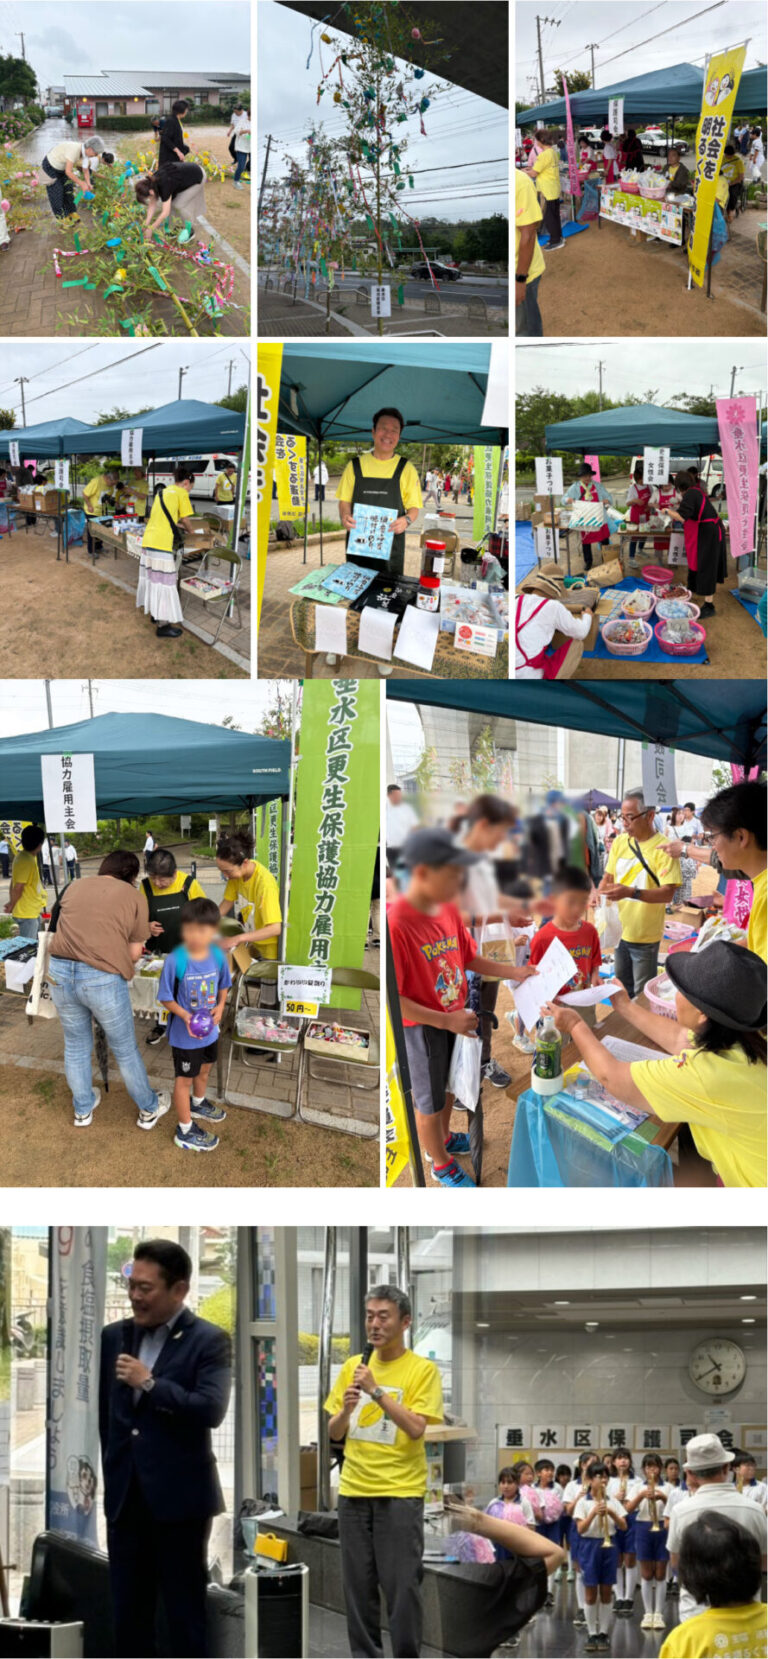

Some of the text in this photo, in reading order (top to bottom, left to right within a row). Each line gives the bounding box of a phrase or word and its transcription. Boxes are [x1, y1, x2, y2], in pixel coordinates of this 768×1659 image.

[703, 116, 726, 180] 社会を
[61, 756, 76, 830] 協力雇用主会
